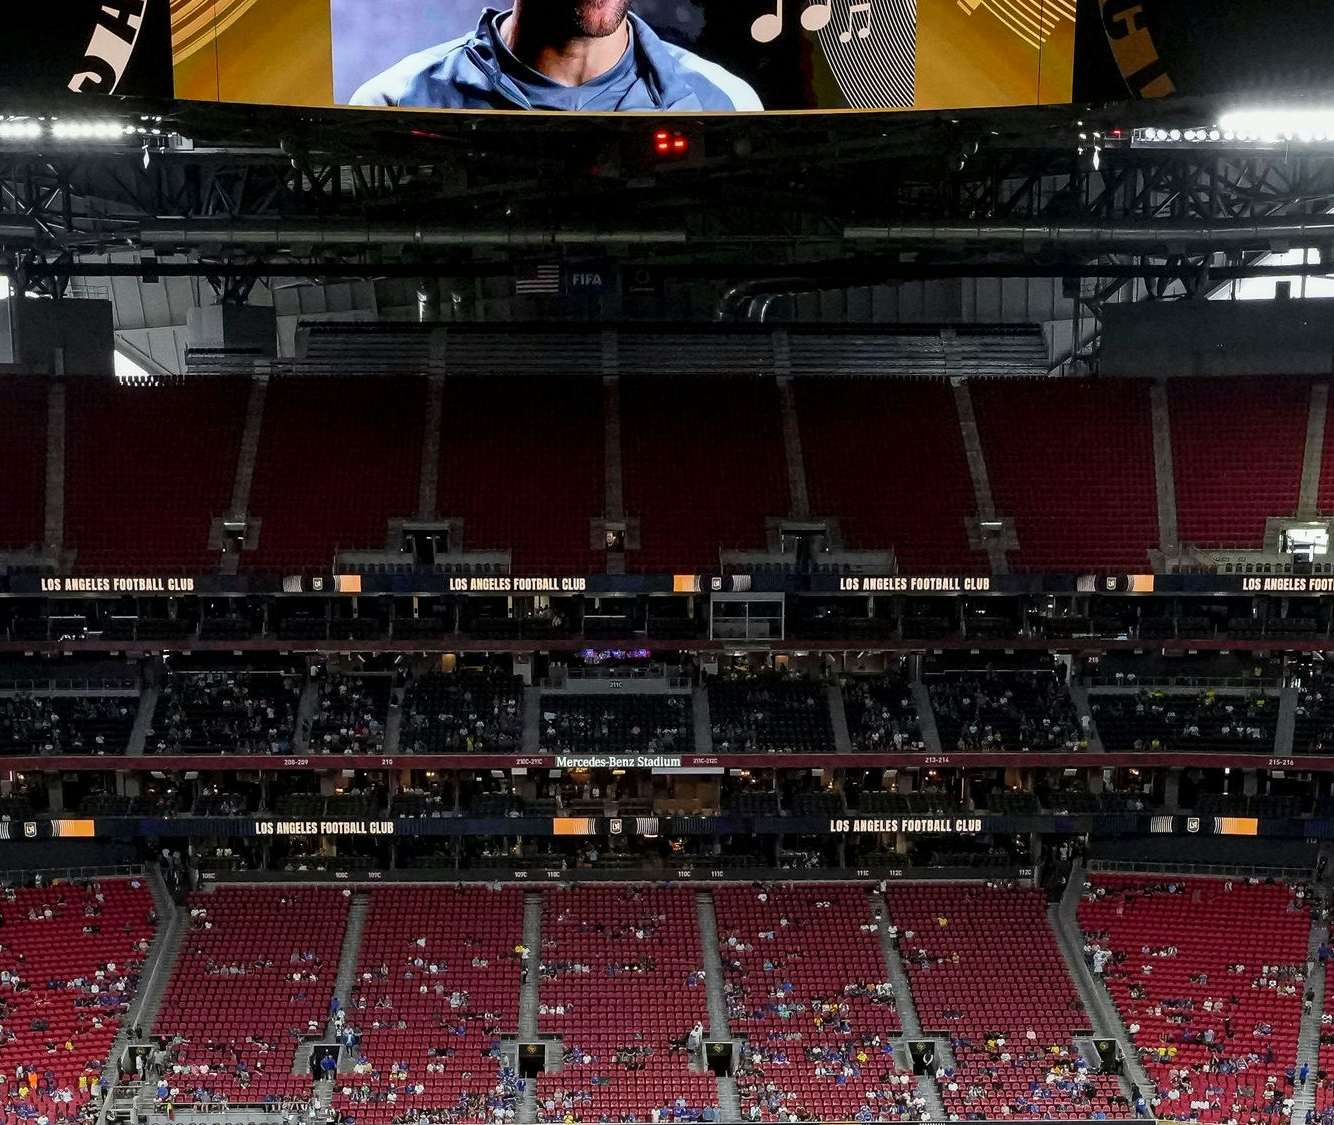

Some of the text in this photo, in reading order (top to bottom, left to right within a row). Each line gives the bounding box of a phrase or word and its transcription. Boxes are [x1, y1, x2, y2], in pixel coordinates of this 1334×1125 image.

[572, 273, 603, 286] FIFA
[41, 578, 194, 591] LOS ANGELES FOOTBALL CLUB
[449, 577, 586, 591] LOS ANGELES FOOTBALL CLUB
[840, 577, 989, 591] LOS ANGELES FOOTBALL CLUB
[1242, 577, 1261, 591] LOS
[1264, 577, 1306, 591] ANGELES
[556, 756, 681, 769] Mercedes-Benz Stadium
[256, 821, 394, 835] LOS ANGELES FOOTBALL CLUB
[831, 819, 982, 832] LOS ANGELES FOOTBALL CLUB
